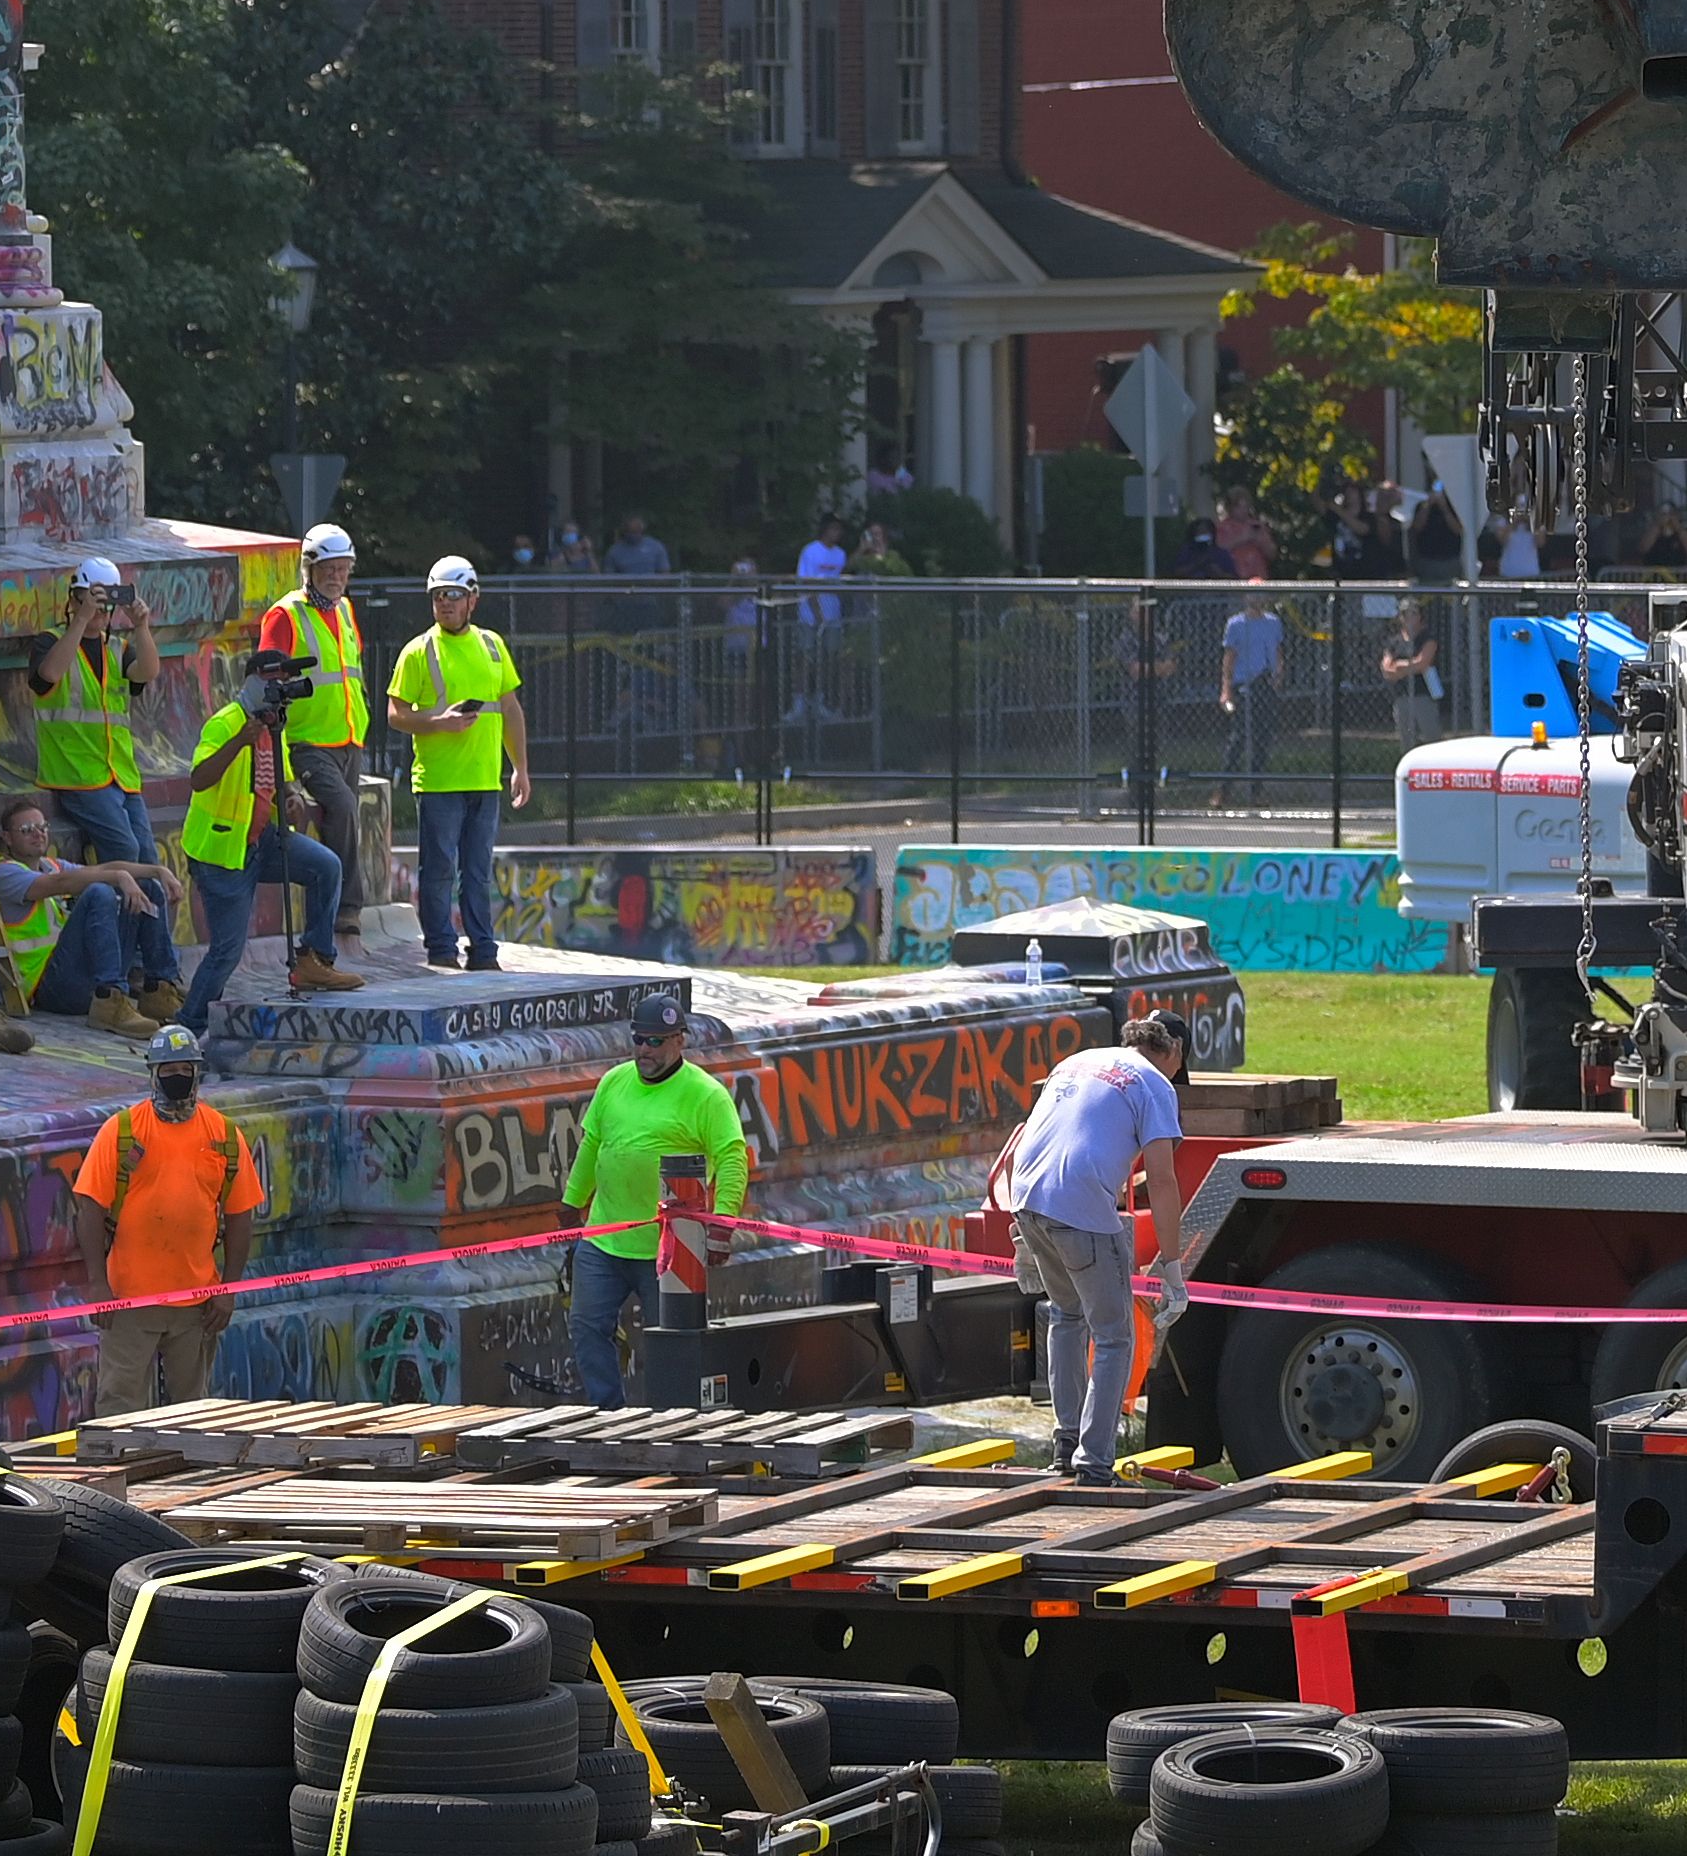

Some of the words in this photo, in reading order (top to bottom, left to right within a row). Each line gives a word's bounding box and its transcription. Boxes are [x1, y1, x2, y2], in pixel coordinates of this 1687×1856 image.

[1413, 772, 1444, 789] SALES
[1450, 772, 1493, 789] RENTALS
[1500, 776, 1540, 793] SERVICE
[1546, 778, 1578, 795] PARTS
[445, 1006, 501, 1039] CASEY
[334, 1808, 348, 1850] HUSKY
